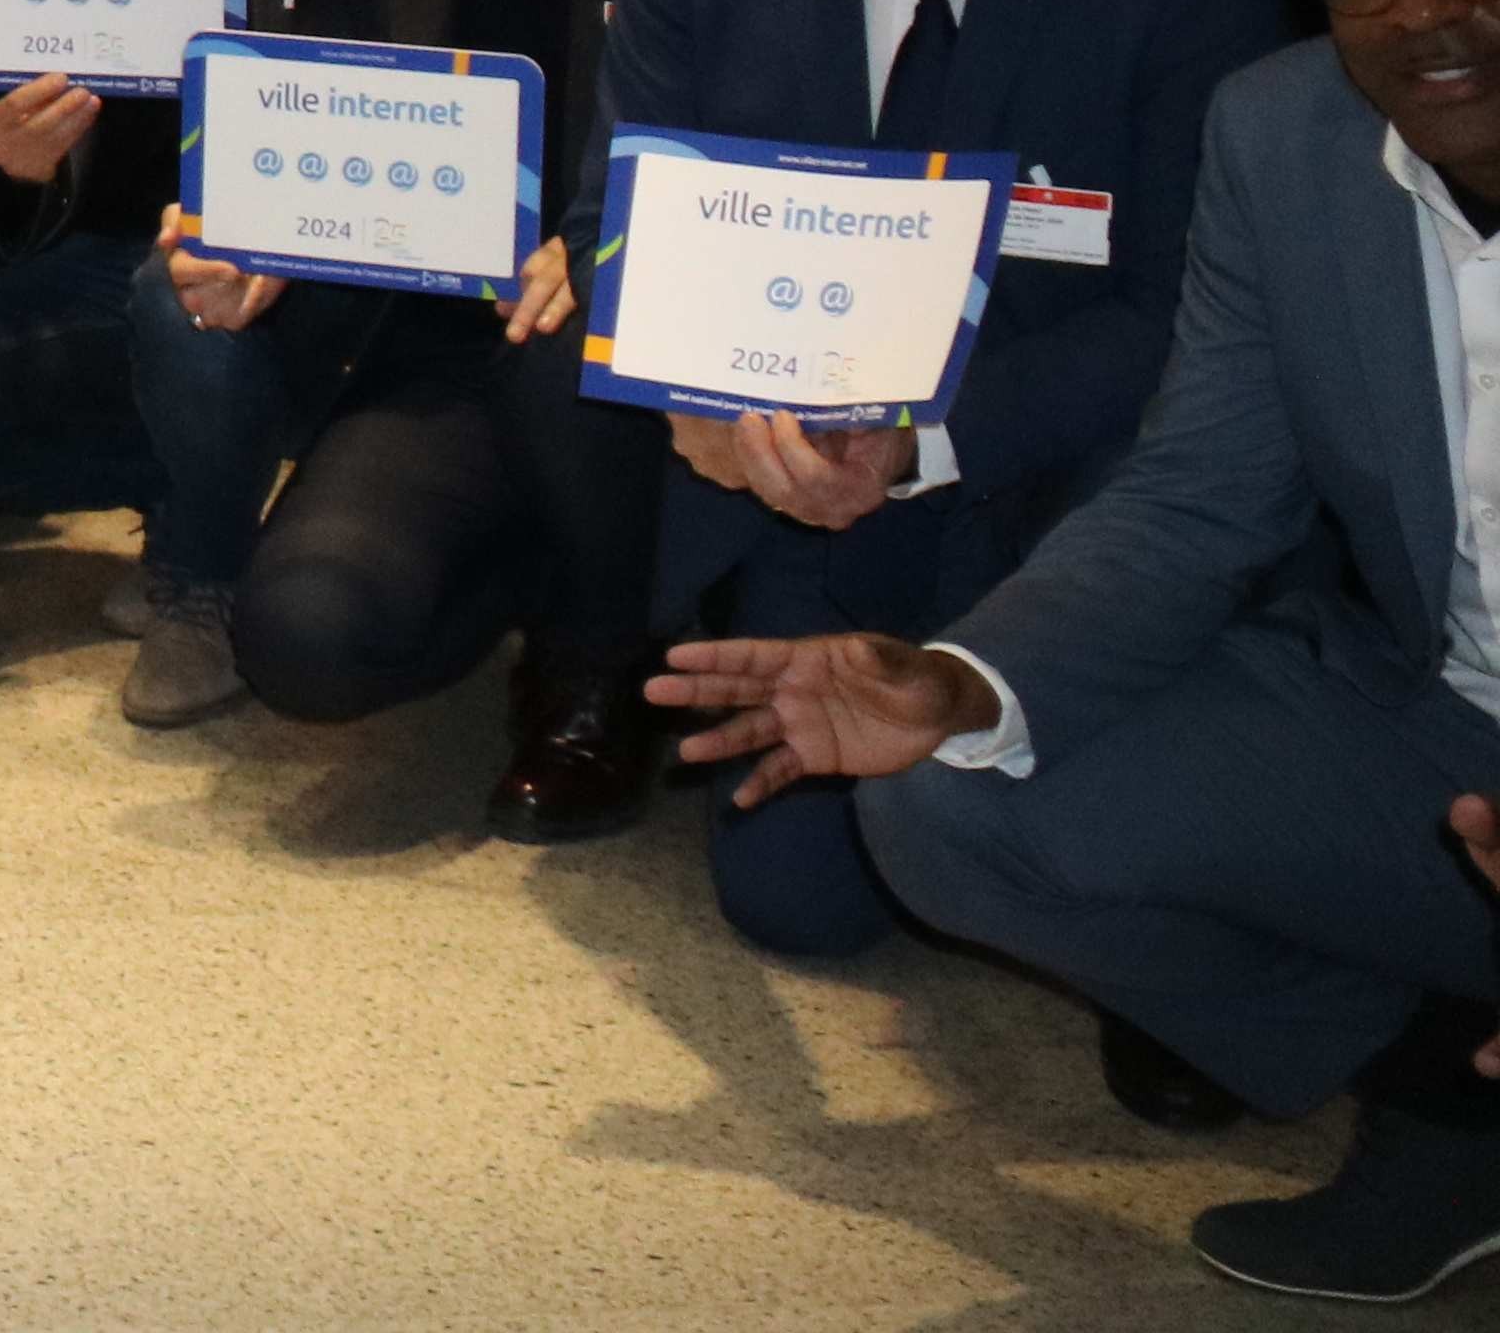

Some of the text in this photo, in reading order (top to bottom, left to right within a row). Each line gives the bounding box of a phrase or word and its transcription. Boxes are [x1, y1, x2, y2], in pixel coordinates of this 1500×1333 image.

[23, 35, 75, 55] 2024
[257, 81, 464, 128] ville internet
[296, 215, 352, 240] 2024
[698, 189, 932, 240] ville internet
[729, 347, 798, 378] 2024
